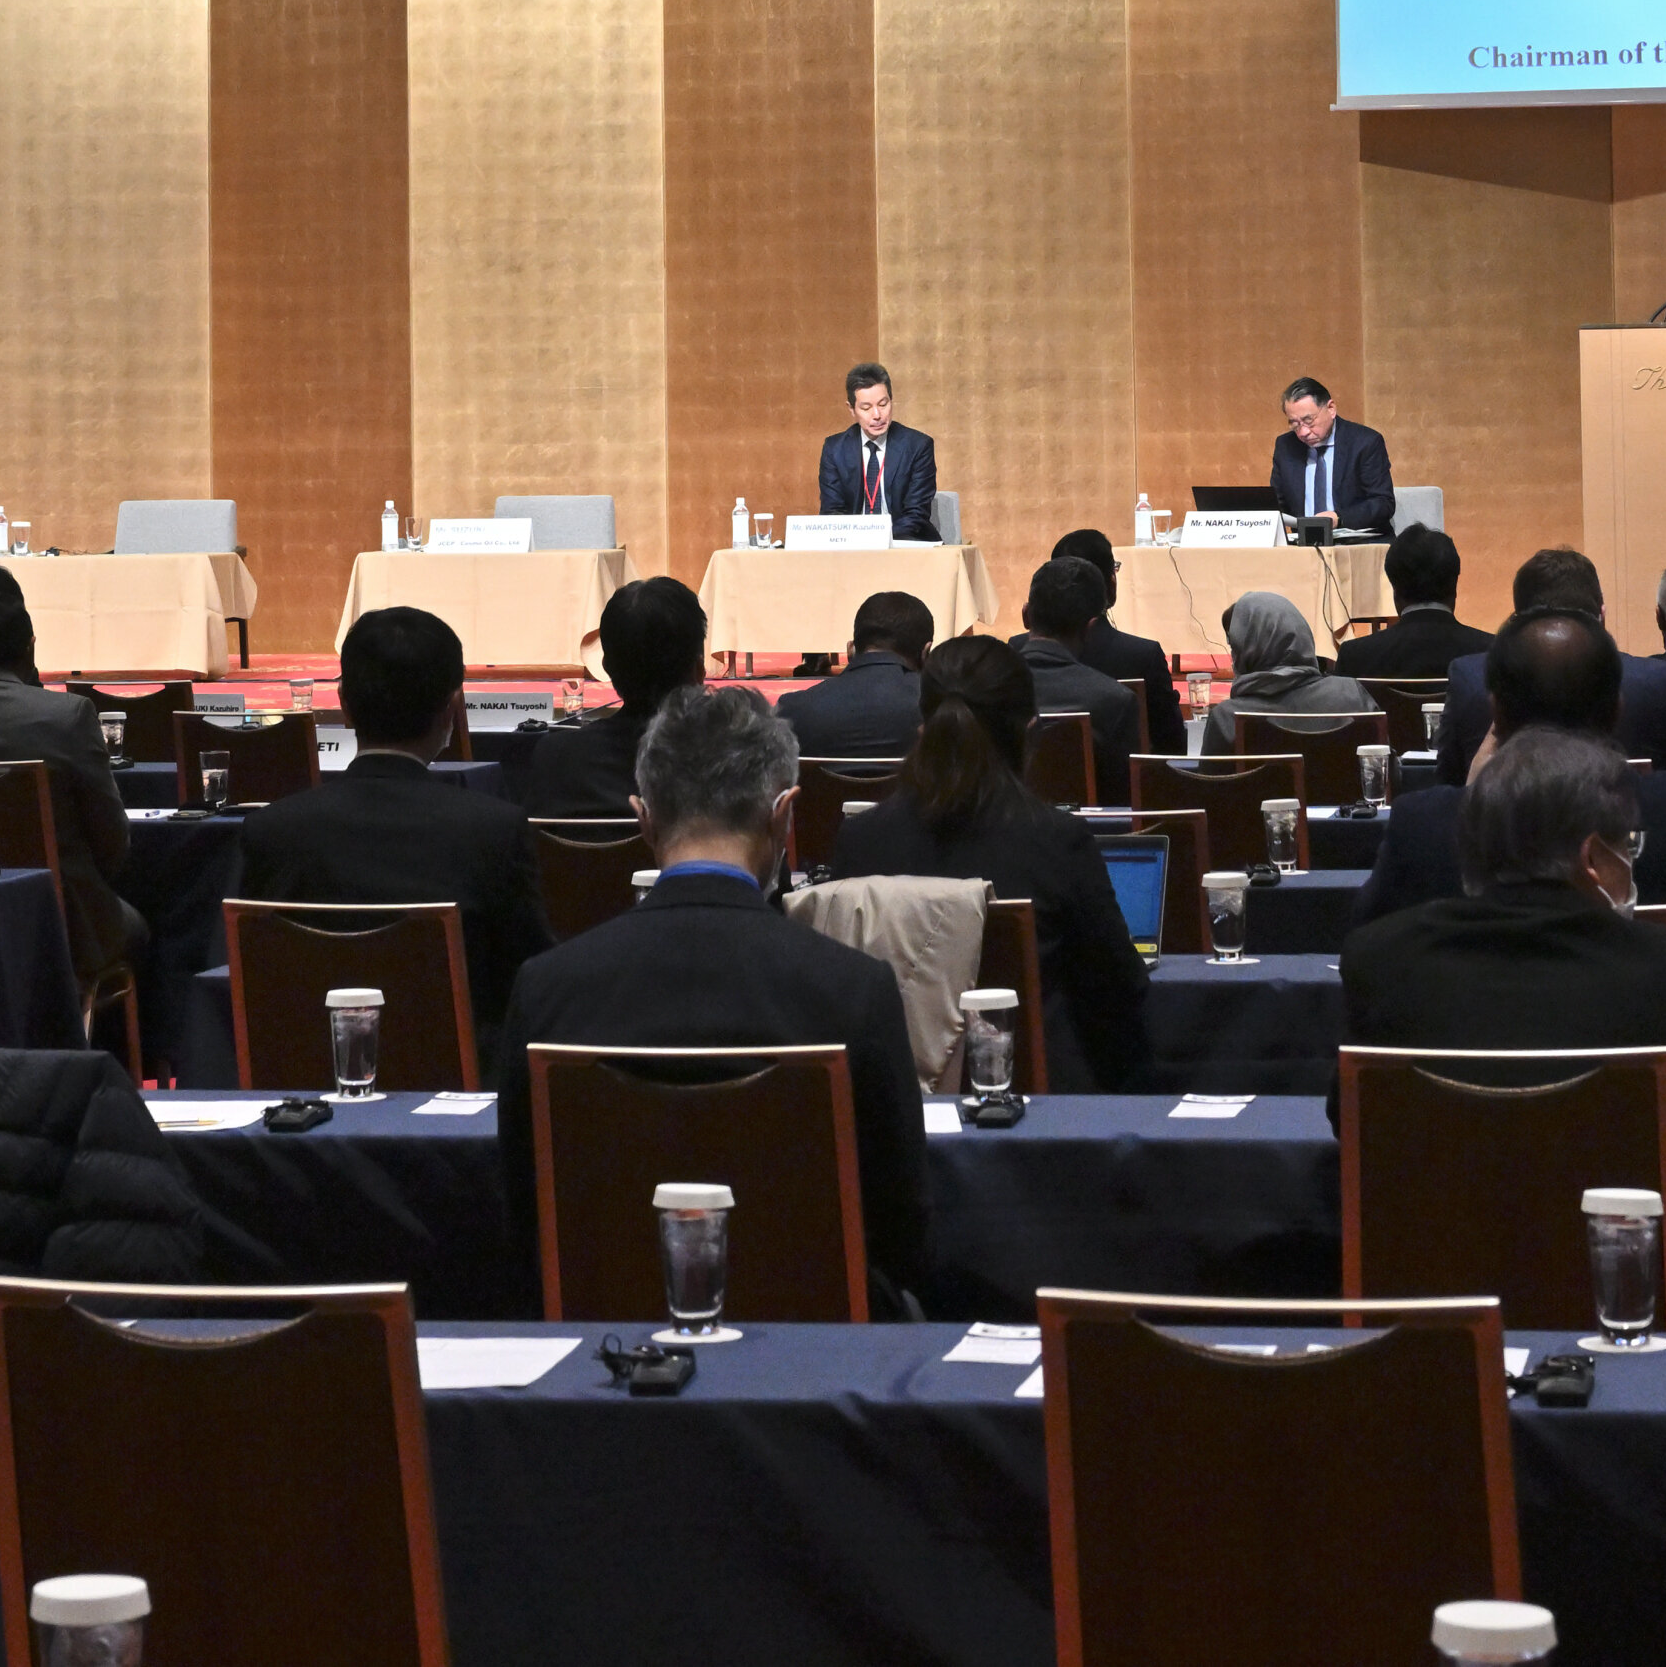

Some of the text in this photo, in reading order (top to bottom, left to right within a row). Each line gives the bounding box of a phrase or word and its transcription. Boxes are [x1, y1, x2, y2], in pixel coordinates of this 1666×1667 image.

[1468, 45, 1609, 69] Chairman
[1618, 41, 1647, 64] of
[805, 523, 851, 531] WAKATSUKI
[853, 523, 885, 531] Kazuhiro
[1191, 518, 1271, 528] Mr. NAKAI Tsuyoshi
[480, 702, 508, 710] NAKAI
[510, 702, 547, 711] Tsuyoshi
